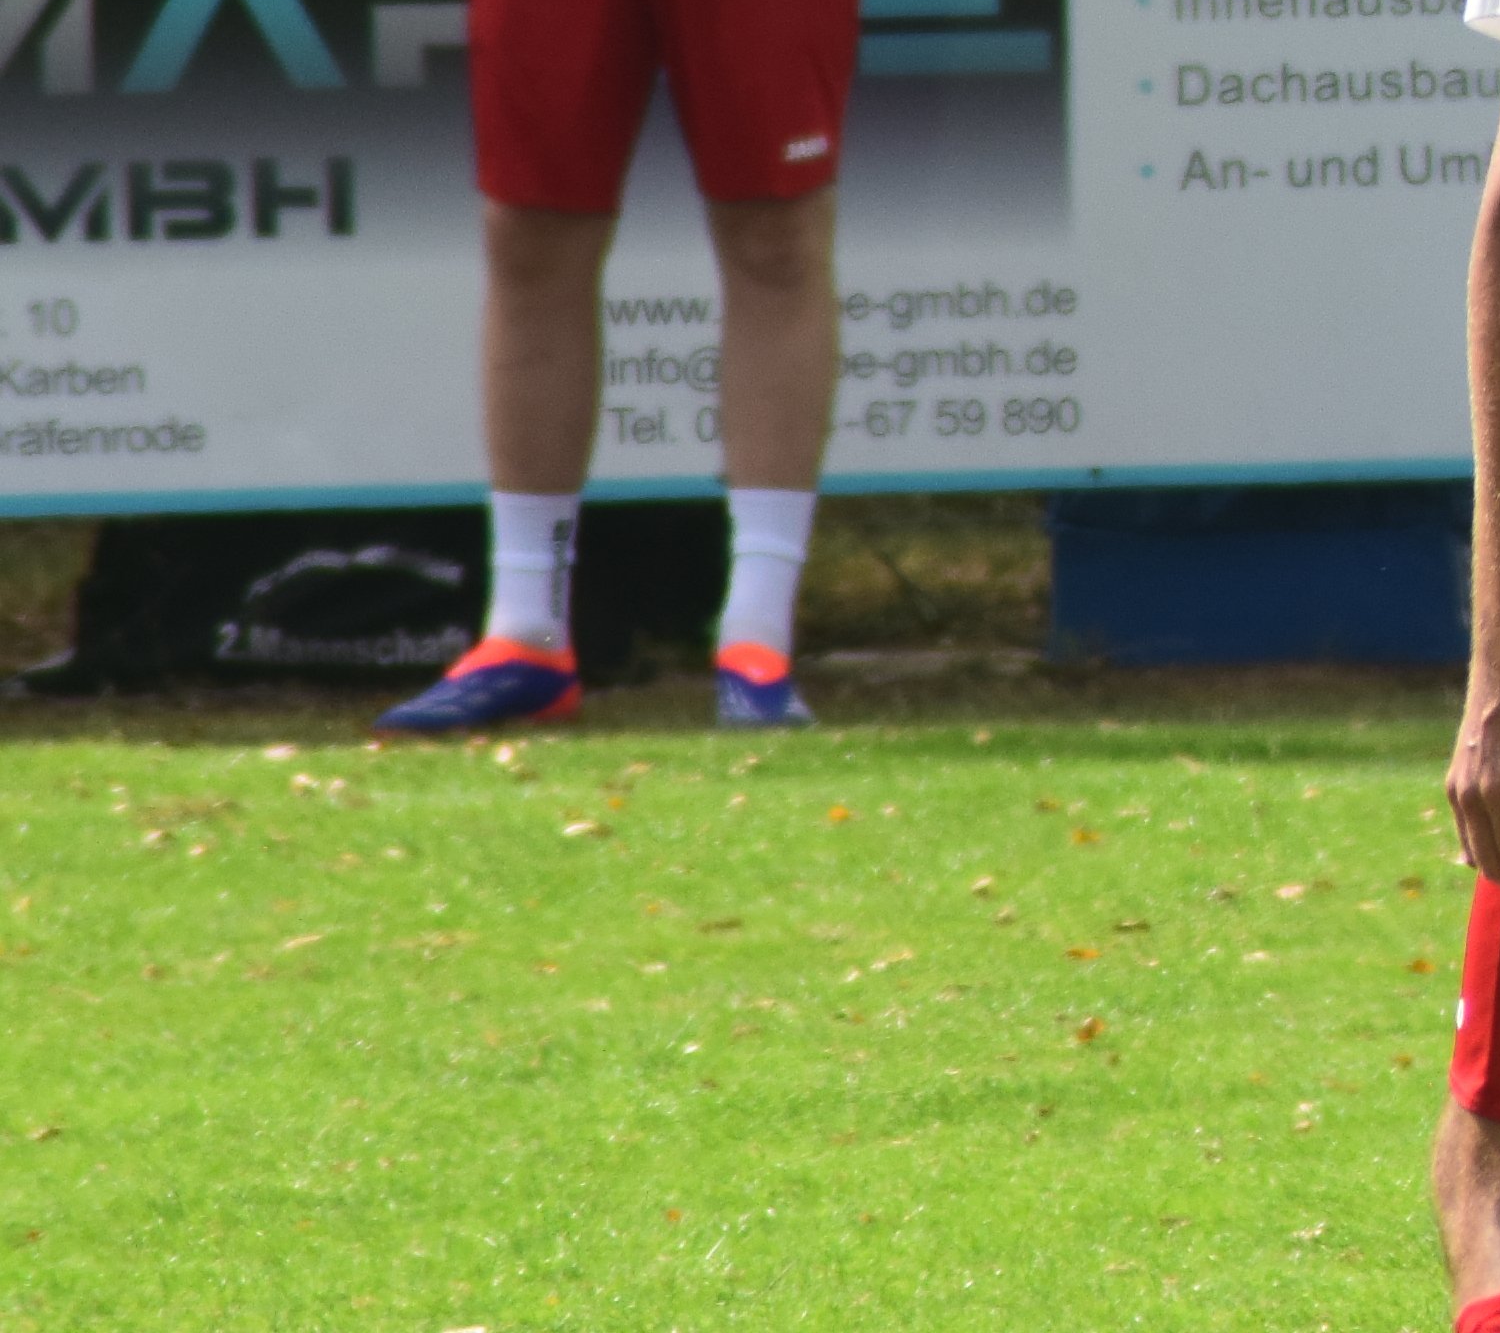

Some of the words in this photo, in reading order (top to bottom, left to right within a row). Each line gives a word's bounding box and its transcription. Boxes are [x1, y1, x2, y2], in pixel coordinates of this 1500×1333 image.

[1180, 147, 1271, 190] An-
[1287, 146, 1379, 187] und
[28, 297, 79, 337] 10
[605, 405, 676, 445] Tel.
[933, 398, 987, 437] 59
[1003, 395, 1080, 435] 890
